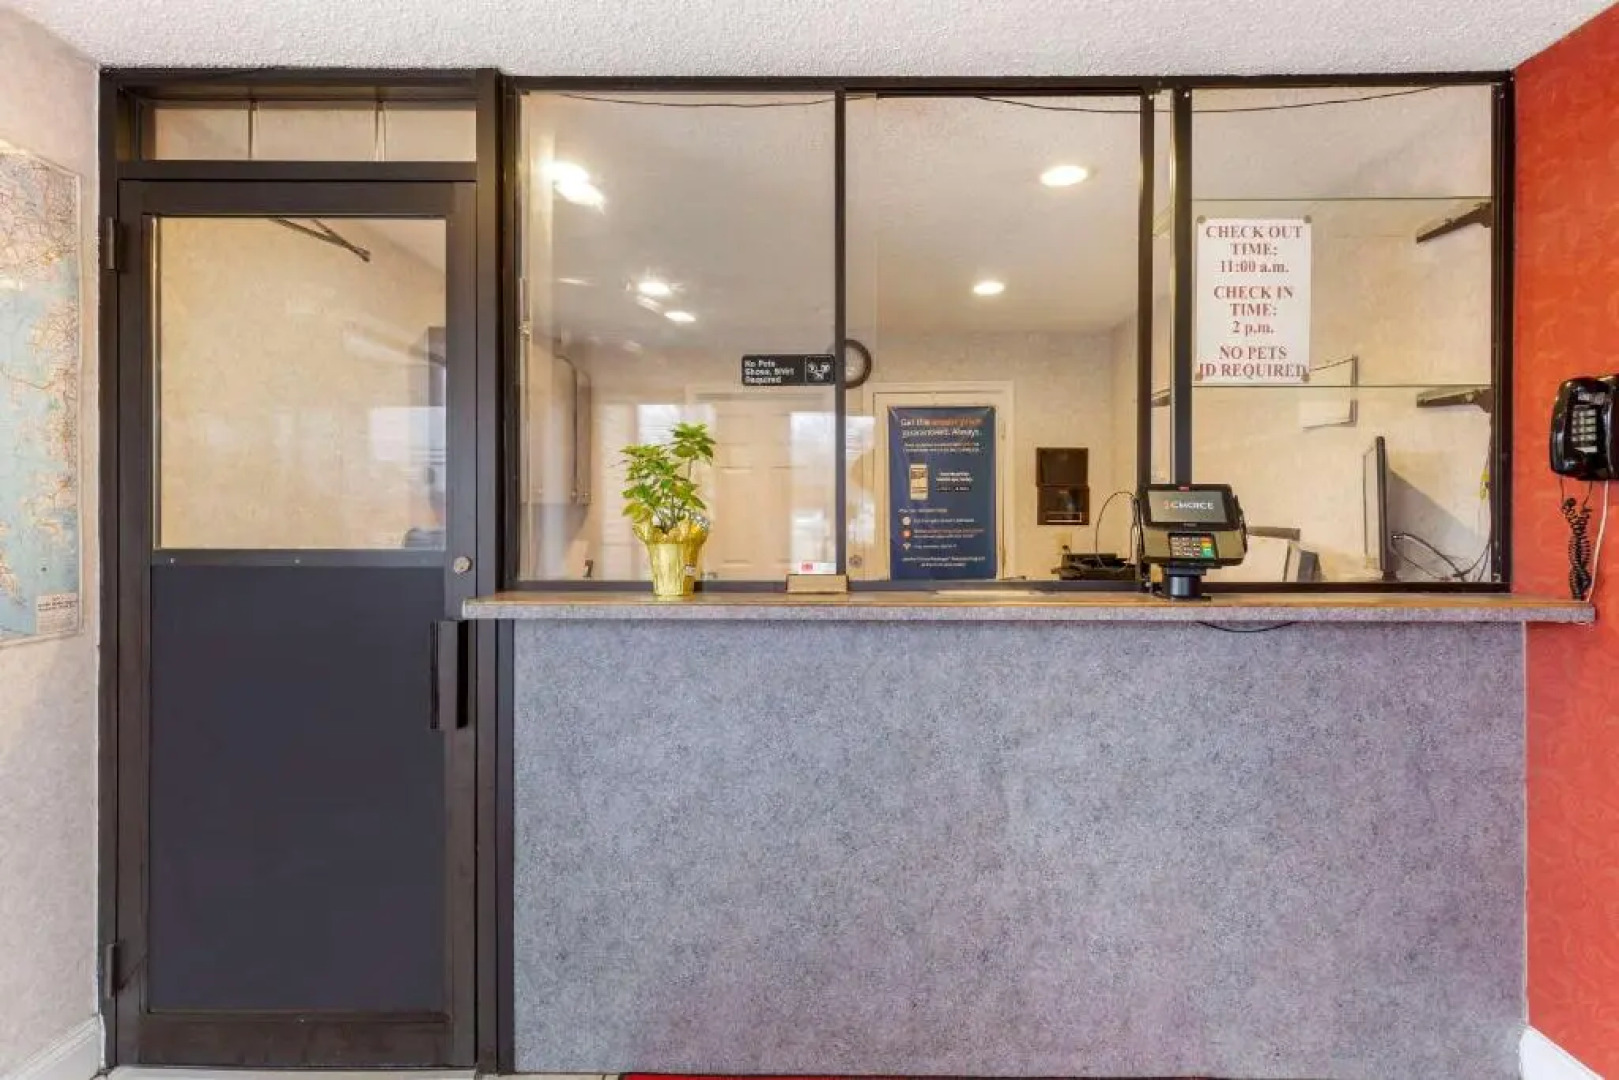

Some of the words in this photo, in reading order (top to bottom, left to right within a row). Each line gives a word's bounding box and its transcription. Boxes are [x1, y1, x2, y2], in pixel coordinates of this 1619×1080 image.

[1206, 225, 1263, 238] CHECK
[1269, 225, 1303, 238] OUT
[1230, 242, 1278, 256] TIME:
[1221, 260, 1256, 273] 11:00
[1259, 263, 1289, 273] a.m.
[1213, 285, 1271, 299] CHECK
[1277, 285, 1294, 299] IN
[1230, 303, 1277, 317] TIME:
[1232, 320, 1240, 333] 2
[1245, 323, 1274, 337] p.m.
[1219, 346, 1243, 360] NO
[1248, 346, 1288, 360] PETS
[1199, 363, 1217, 377] ID
[1221, 363, 1307, 380] REQUIRED
